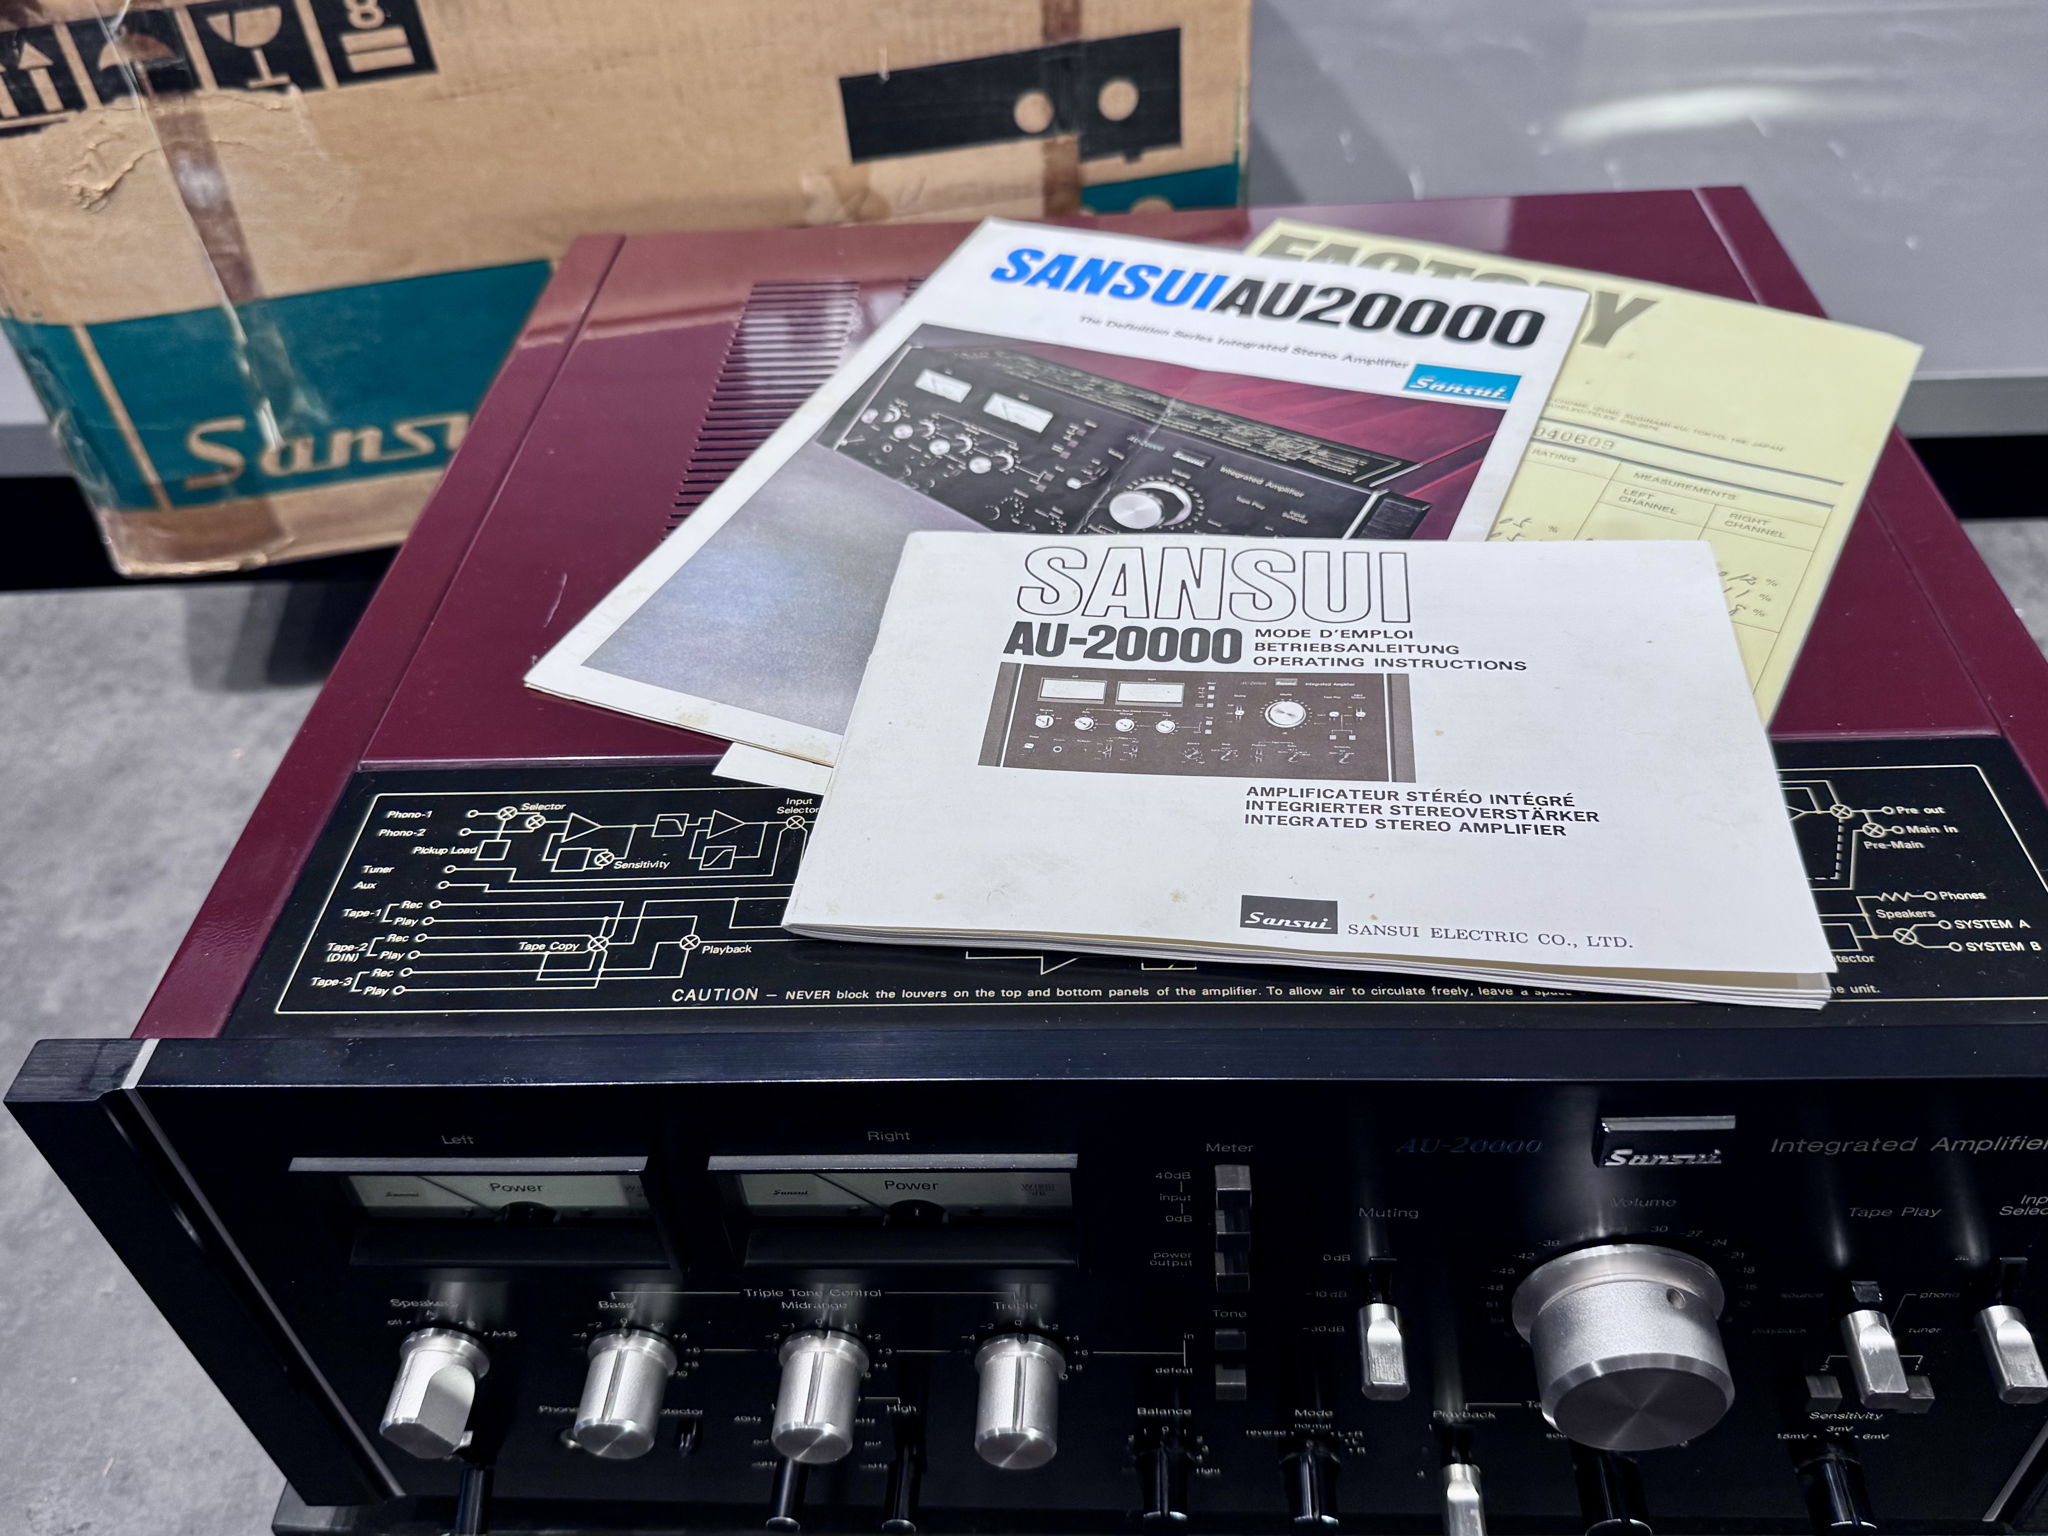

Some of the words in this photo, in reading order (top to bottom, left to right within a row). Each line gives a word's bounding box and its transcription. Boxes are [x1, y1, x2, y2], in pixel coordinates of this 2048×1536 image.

[991, 247, 1230, 310] SANSUI
[1212, 279, 1546, 350] AU20000
[1079, 315, 1101, 325] The
[1105, 320, 1169, 336] Definition
[1174, 330, 1214, 343] Series
[1216, 337, 1288, 354] Integrated
[1290, 346, 1338, 360] Stereo
[1341, 354, 1410, 369] Amplifier
[1409, 375, 1507, 400] Sansui
[1531, 447, 1578, 464] RATING
[1632, 471, 1738, 501] MEASUREMENTS
[1622, 486, 1656, 500] LEFT
[1618, 496, 1678, 516] CHANNEL
[1728, 512, 1773, 526] RIGHT
[1723, 519, 1787, 540] CHANNEL
[1016, 546, 1413, 625] SANSUI
[1254, 628, 1311, 639] MODE
[1319, 628, 1414, 640] D'EMPLOI
[1002, 621, 1243, 665] AU-20000
[1253, 641, 1461, 656] BETRIEBSANLEITUNG
[1252, 655, 1367, 669] OPERATING
[1373, 657, 1528, 672] INSTRUCTIONS
[786, 797, 813, 807] Input
[1245, 786, 1400, 803] AMPLIFICATEUR
[1406, 786, 1484, 805] STÉRÉO
[1489, 788, 1576, 808] INTÉGRÉ
[521, 802, 566, 811] Selector
[1896, 806, 1918, 815] Pre
[1924, 806, 1945, 815] out
[387, 809, 433, 820] Phono-1
[1245, 801, 1384, 817] INTEGRIERTER
[1388, 802, 1601, 824] STEREOVERSTÄRKER
[1244, 814, 1370, 830] INTEGRATED
[1375, 818, 1452, 834] STEREO
[1458, 821, 1568, 837] AMPLIFIER
[1906, 825, 1940, 834] Main
[1944, 825, 1958, 834] in
[378, 828, 426, 838] Phono-2
[1864, 841, 1924, 850] Pre-Main
[412, 846, 450, 857] Pickup
[453, 846, 478, 855] Load
[362, 865, 395, 874] Tuner
[614, 859, 670, 871] Sensitivity
[355, 881, 377, 890] Aux
[1939, 890, 1987, 900] Phones
[401, 900, 423, 909] Rec
[343, 909, 382, 920] Tape-1
[1876, 910, 1936, 919] Speakers
[395, 917, 419, 928] Play
[1245, 911, 1332, 932] Sansui
[1953, 919, 2011, 929] SYSTEM
[387, 934, 409, 943] Rec
[1347, 923, 1420, 940] SANSUI
[1430, 927, 1529, 945] ELECTRIC
[1537, 932, 1579, 949] CO.,
[1586, 935, 1635, 951] LTD.
[327, 943, 367, 954] Tape-2
[518, 942, 546, 953] Tape
[549, 942, 580, 953] Copy
[702, 944, 752, 956] Playback
[1965, 942, 2024, 952] SYSTEM
[326, 951, 360, 963] (DIN)
[379, 950, 405, 961] Play
[372, 968, 394, 977] Rec
[311, 977, 352, 988] Tape-3
[364, 986, 389, 997] Play
[671, 987, 759, 1002] CAUTION
[785, 989, 831, 1000] NEVER
[836, 989, 869, 999] block
[875, 988, 896, 999] the
[901, 988, 947, 999] louvers
[953, 990, 969, 999] on
[974, 988, 996, 998] the
[1001, 988, 1022, 1000] top
[1027, 987, 1050, 998] and
[1056, 987, 1102, 998] bottom
[1109, 987, 1149, 999] panels
[1156, 986, 1171, 997] of
[1175, 986, 1196, 997] the
[1202, 986, 1261, 999] amplifier.
[1266, 986, 1283, 997] To
[1289, 986, 1323, 997] allow
[1329, 986, 1346, 997] air
[1351, 986, 1366, 997] to
[1371, 986, 1426, 997] circulate
[1431, 985, 1474, 999] freely,
[1478, 986, 1514, 997] leave
[1849, 983, 1881, 994] unit.
[441, 1134, 475, 1145] Left
[867, 1130, 911, 1143] Right
[1205, 1142, 1254, 1153] Meter
[1397, 1136, 1544, 1154] AU-20000
[1770, 1137, 1918, 1156] Integrated
[1604, 1149, 1723, 1167] Sansui
[1155, 1171, 1192, 1180] 40dB
[489, 1182, 545, 1193] Power
[884, 1180, 939, 1191] Power
[1159, 1193, 1192, 1203] input
[1611, 1197, 1678, 1208] Volume
[1358, 1208, 1419, 1219] Muting
[1849, 1207, 1893, 1218] Tape
[1900, 1206, 1942, 1218] Play
[1165, 1214, 1193, 1223] 0dB
[1152, 1252, 1193, 1261] power
[1150, 1259, 1193, 1268] output
[743, 1288, 784, 1298] Triple
[788, 1288, 824, 1297] Tone
[829, 1288, 882, 1297] Control
[1919, 1291, 1961, 1300] phono
[598, 1301, 634, 1309] Bass
[781, 1301, 848, 1311] Midrange
[1212, 1309, 1248, 1318] Tone
[1908, 1327, 1943, 1335] tuner
[1155, 1367, 1194, 1375] defeat
[885, 1404, 917, 1414] High
[1137, 1407, 1192, 1417] Balance
[1294, 1409, 1334, 1418] Mode
[1432, 1409, 1497, 1420] Playback
[1809, 1411, 1884, 1421] Sensitivity
[1245, 1429, 1287, 1437] reverse
